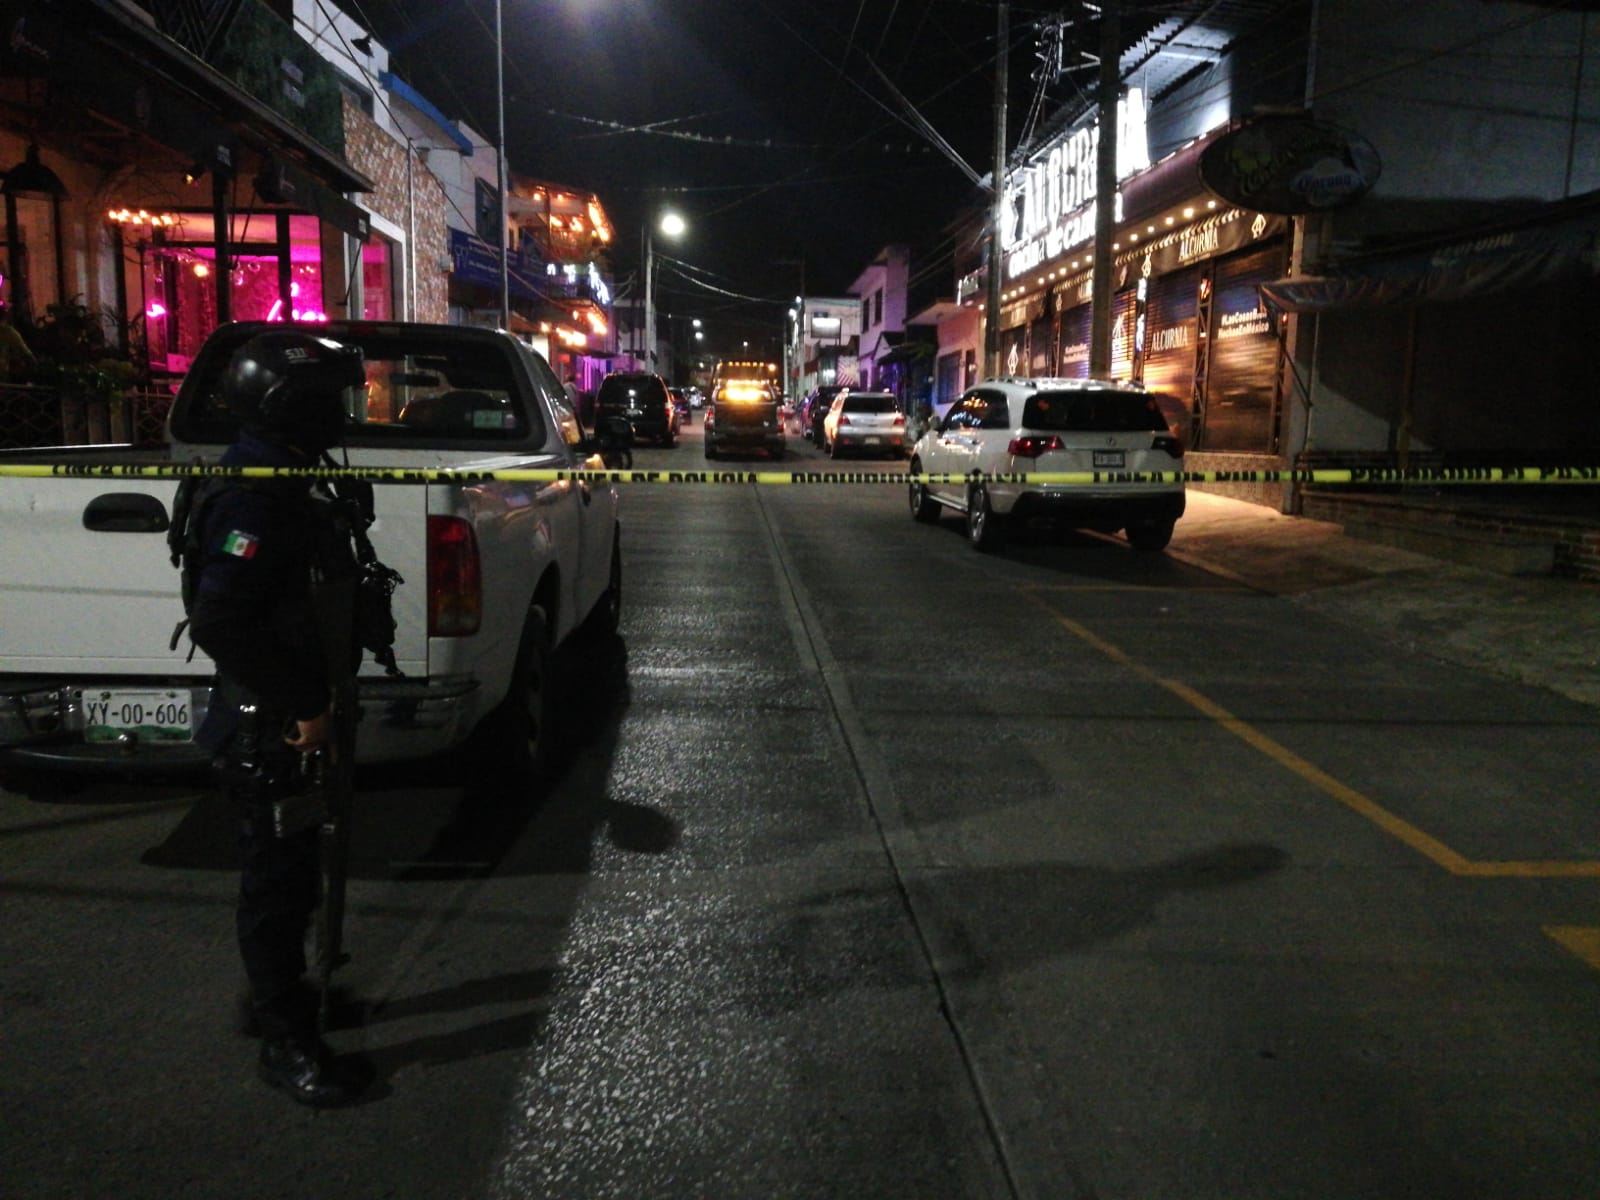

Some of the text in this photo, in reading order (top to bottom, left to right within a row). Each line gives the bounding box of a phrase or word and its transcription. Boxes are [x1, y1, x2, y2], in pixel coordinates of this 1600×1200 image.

[1022, 86, 1151, 238] ALCURIA
[1178, 227, 1219, 262] ALCURNIA
[1152, 326, 1189, 351] ALCURNIA
[87, 702, 188, 725] XY-00-606
